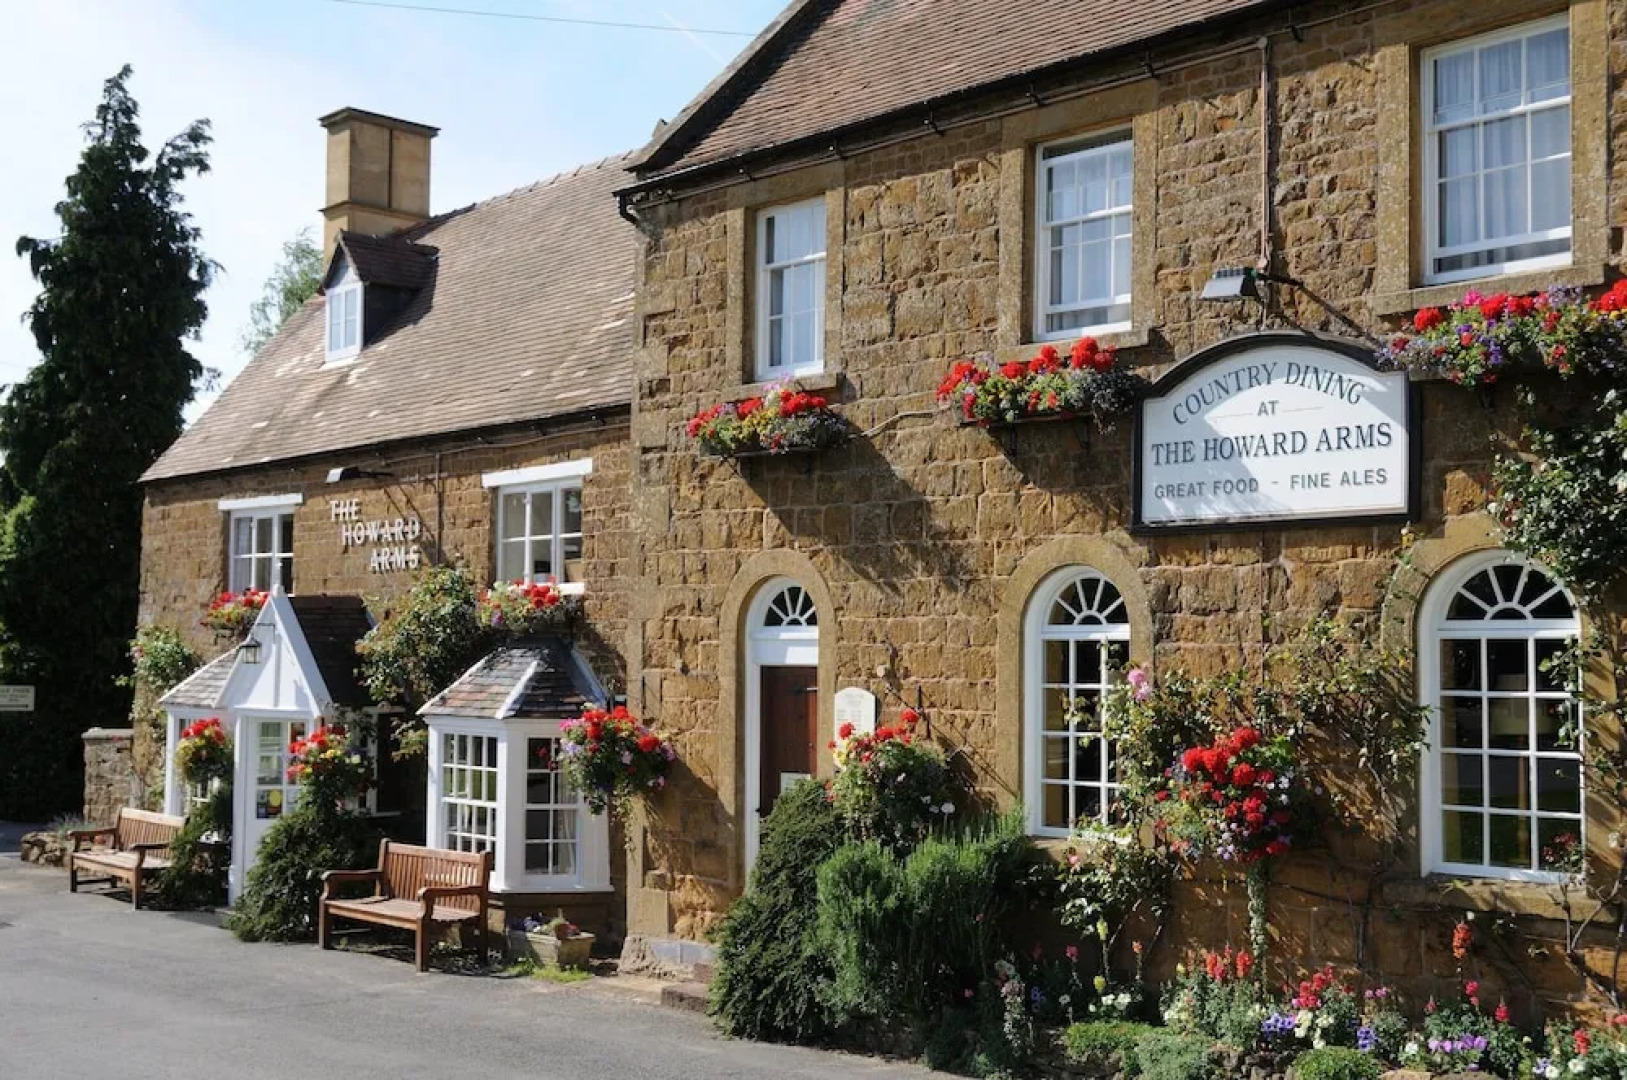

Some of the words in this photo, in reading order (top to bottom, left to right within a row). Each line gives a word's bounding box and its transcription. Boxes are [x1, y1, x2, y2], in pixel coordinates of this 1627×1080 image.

[1172, 362, 1279, 425] COUNTRY
[1284, 361, 1367, 405] DINING
[1257, 400, 1279, 417] AT
[1151, 440, 1195, 466] THE
[1203, 430, 1308, 461] HOWARD
[1315, 422, 1393, 451] ARMS
[1154, 481, 1205, 500] GREAT
[1213, 477, 1259, 495] FOOD
[1290, 473, 1331, 490] FINE
[1340, 468, 1388, 487] ALES
[329, 498, 360, 521] THE
[342, 516, 420, 546] HOWARD
[370, 545, 419, 572] ARMS
